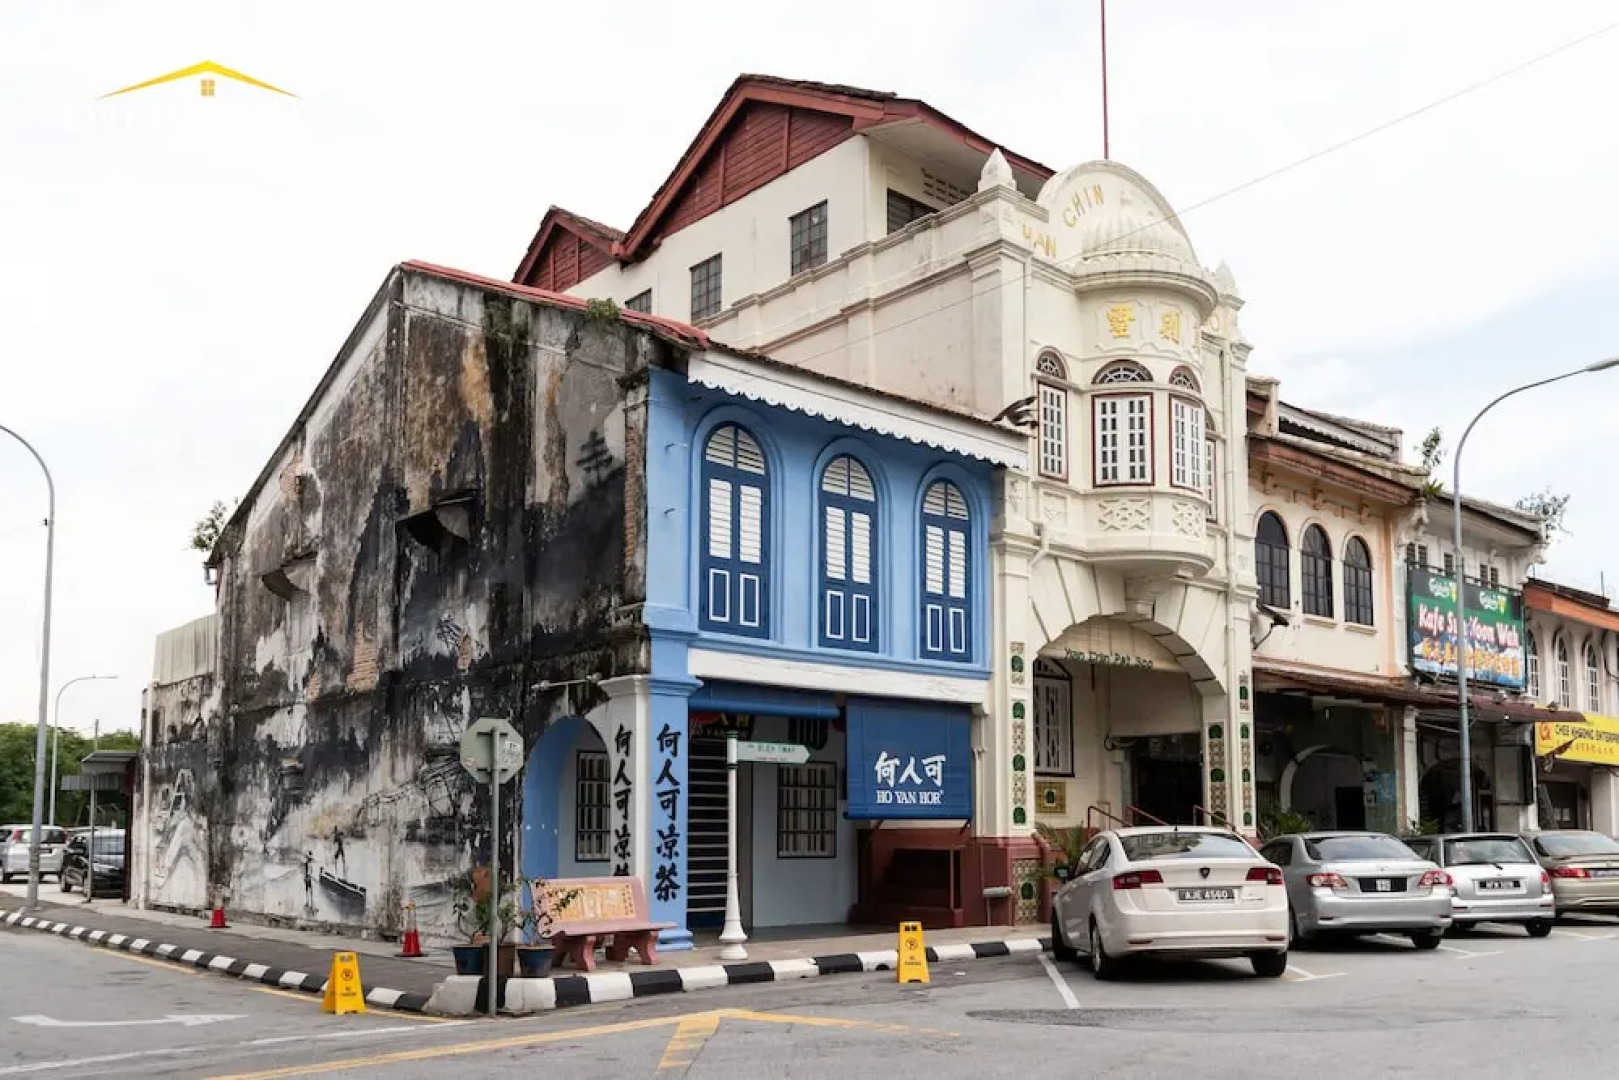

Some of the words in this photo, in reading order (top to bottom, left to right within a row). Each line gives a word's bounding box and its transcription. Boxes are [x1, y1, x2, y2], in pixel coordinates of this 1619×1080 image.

[1062, 183, 1105, 227] CHIN
[1418, 603, 1445, 637] Kafe
[874, 751, 947, 788] 何人可
[876, 789, 893, 804] HO
[894, 790, 917, 804] YAN
[918, 791, 942, 804] HOR
